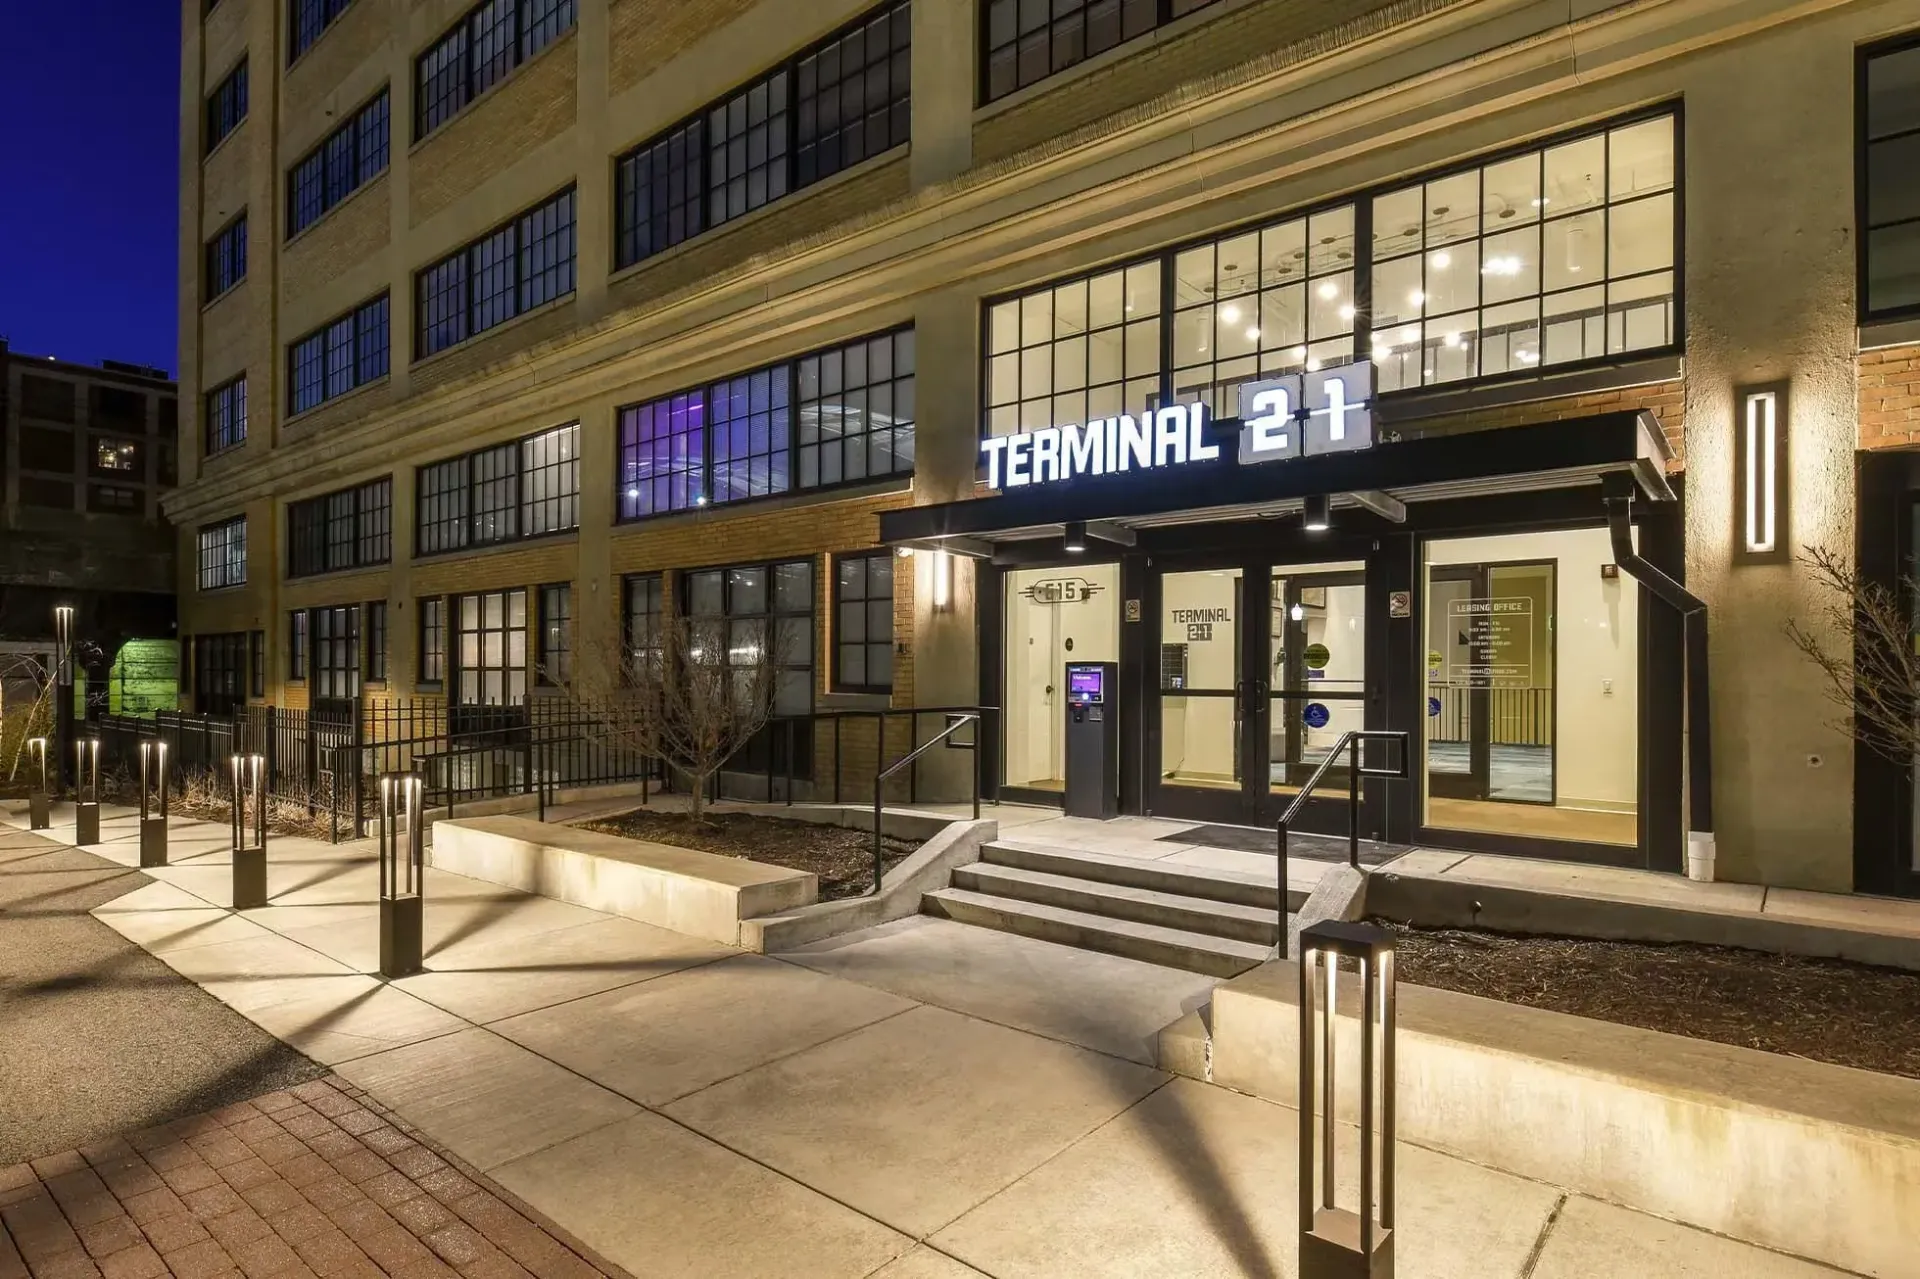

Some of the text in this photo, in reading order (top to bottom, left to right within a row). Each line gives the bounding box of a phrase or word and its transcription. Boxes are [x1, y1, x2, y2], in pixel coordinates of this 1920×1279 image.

[980, 402, 1219, 490] TERMINAL
[1457, 603, 1522, 612] LEASING OFFICE
[1172, 608, 1231, 623] TERMINAL
[1188, 624, 1211, 640] 21
